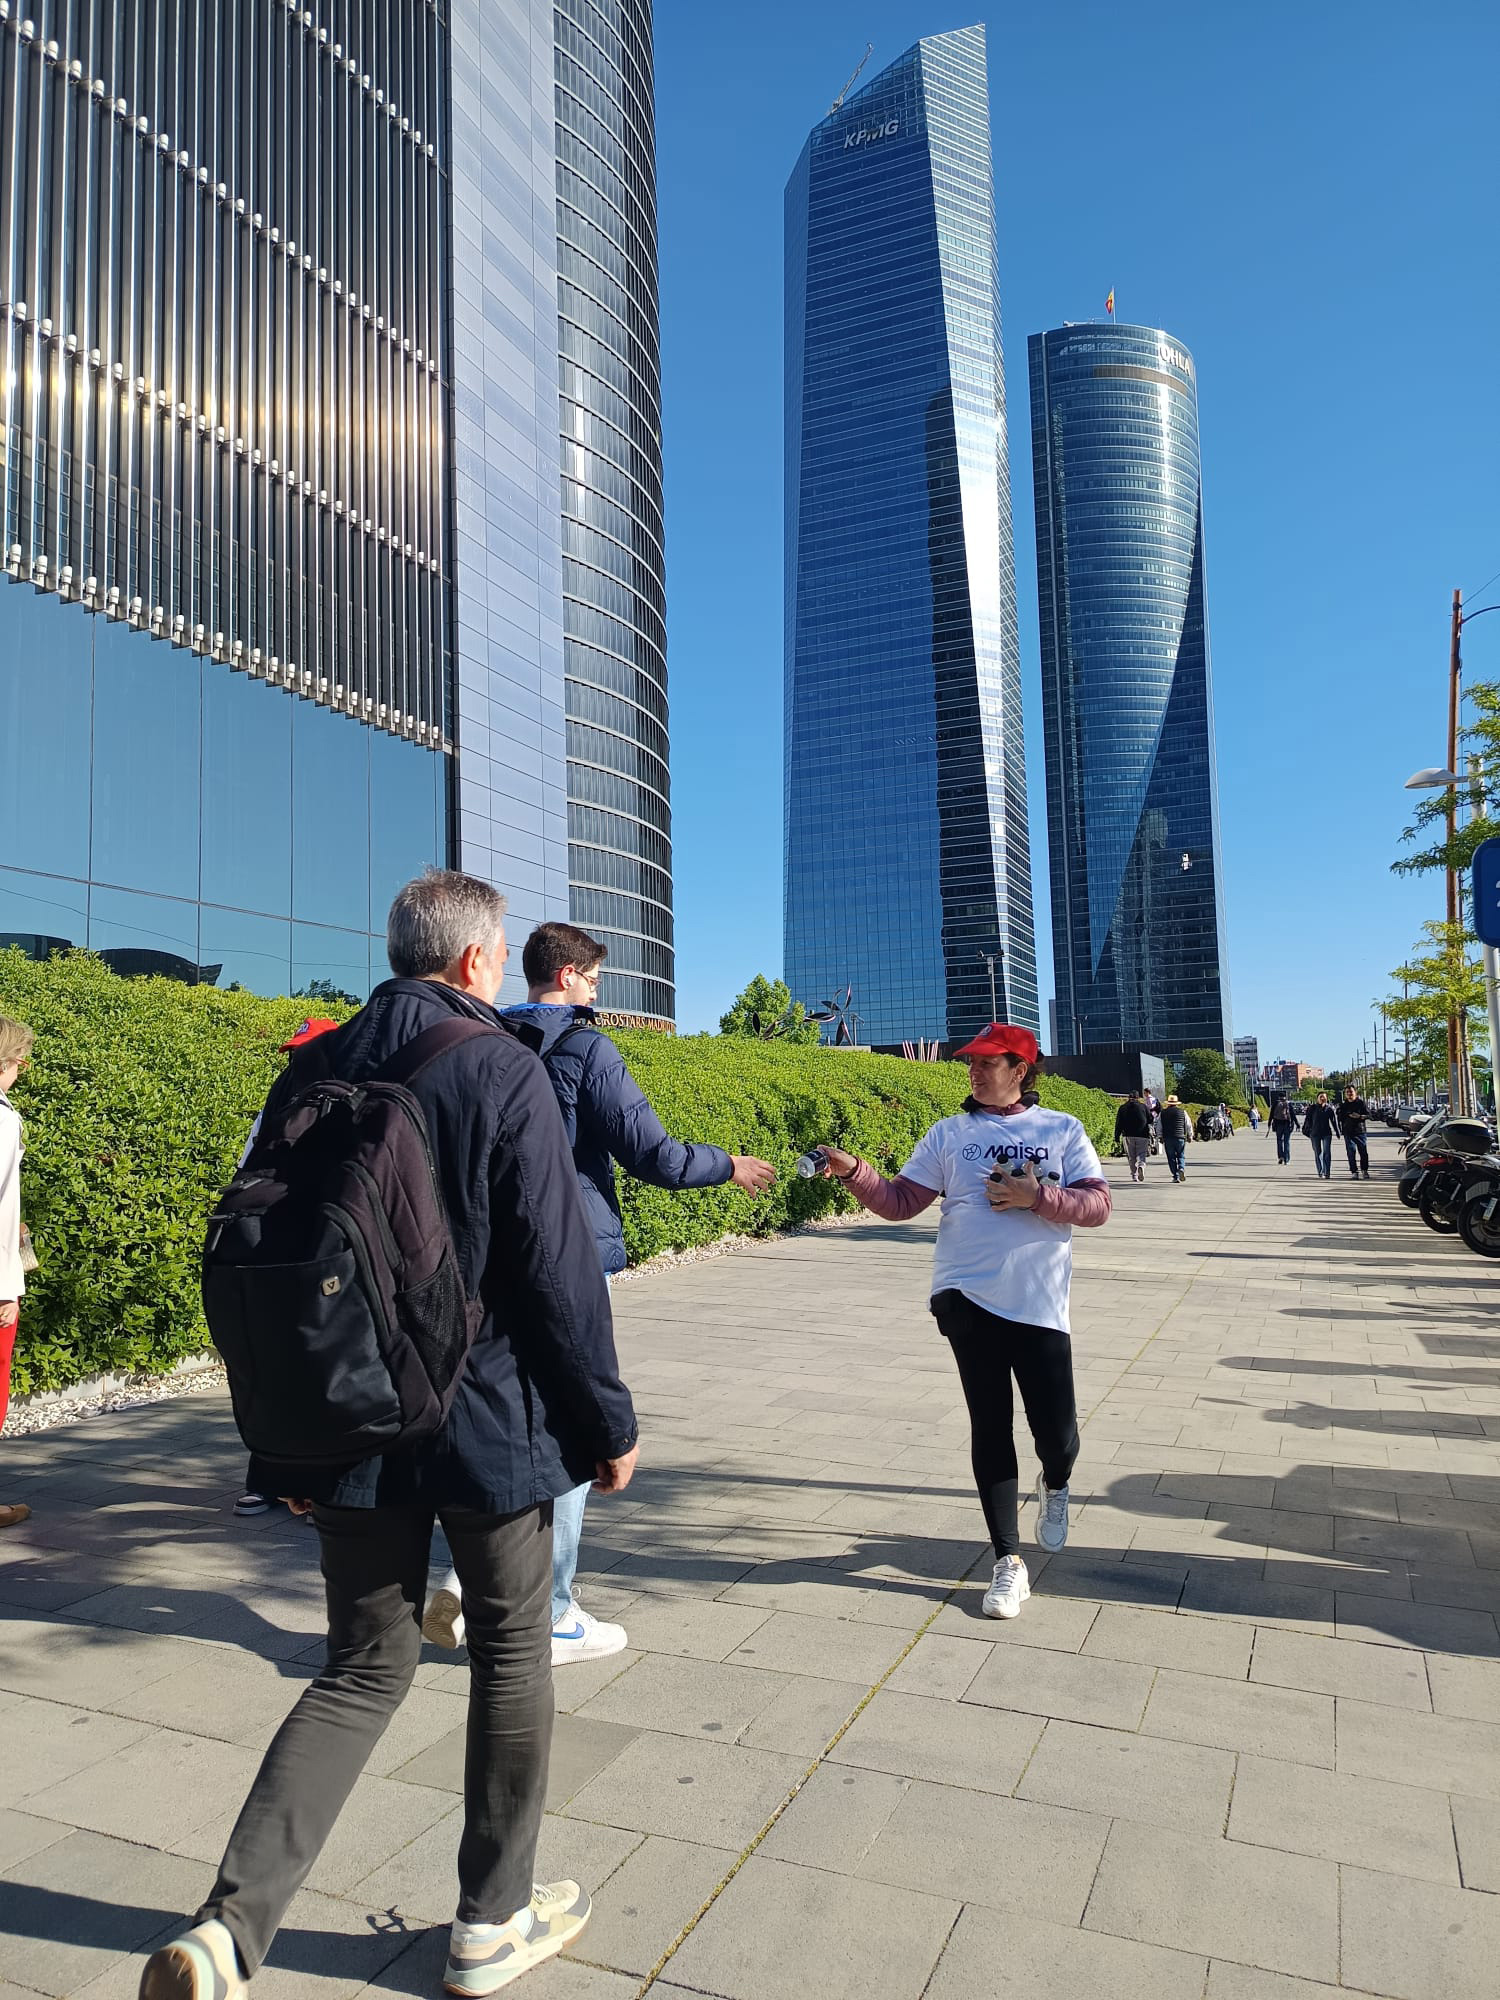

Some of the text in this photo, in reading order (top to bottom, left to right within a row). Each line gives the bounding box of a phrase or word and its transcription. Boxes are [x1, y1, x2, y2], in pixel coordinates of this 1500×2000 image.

[843, 119, 899, 149] KPMG
[1159, 344, 1191, 377] OHLA
[586, 1012, 645, 1029] UROSTARS
[984, 1142, 1049, 1160] Maisa
